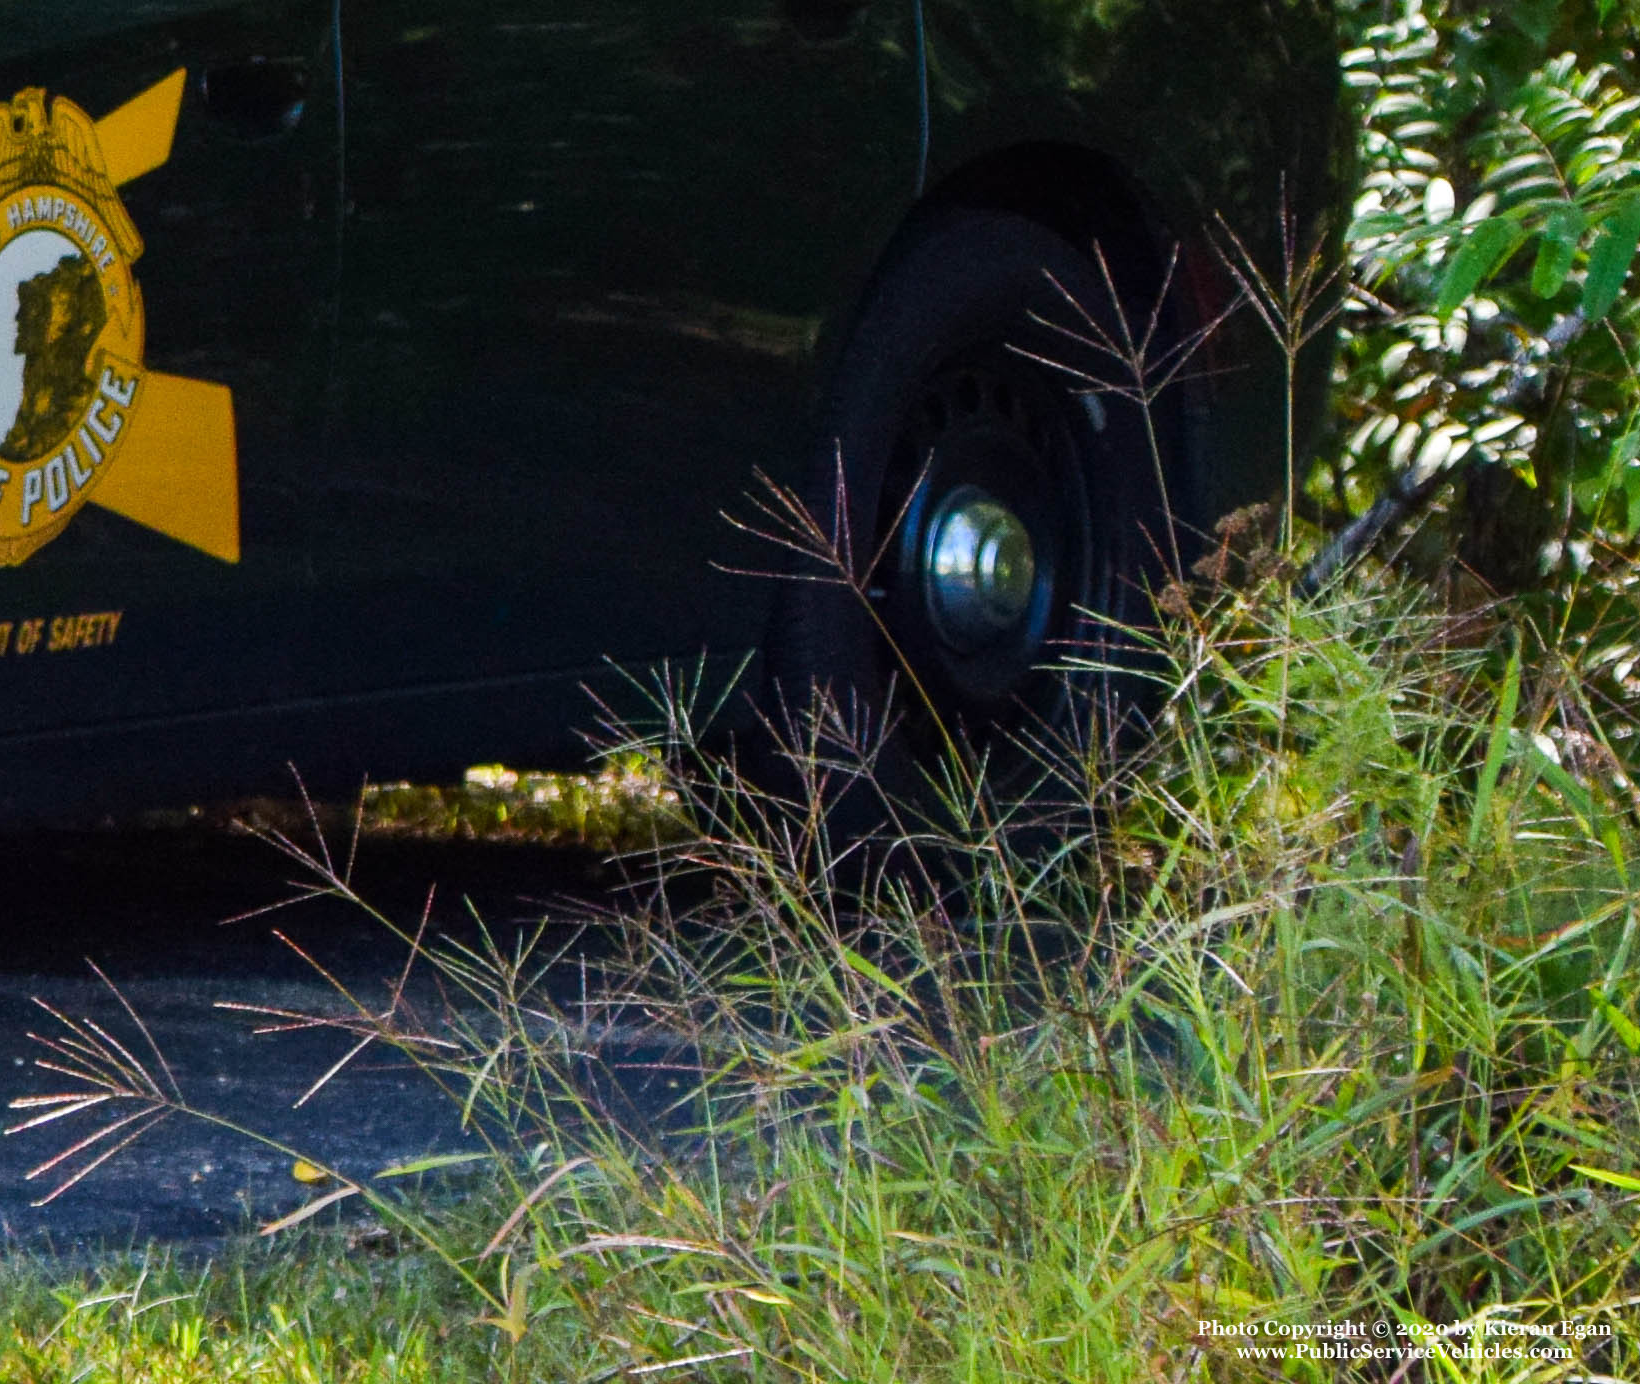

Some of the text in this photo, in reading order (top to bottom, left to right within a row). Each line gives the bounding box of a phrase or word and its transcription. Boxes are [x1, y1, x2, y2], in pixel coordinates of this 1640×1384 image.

[6, 196, 115, 272] HAMPSHIRE
[21, 367, 139, 526] POLICE
[16, 617, 45, 655] OF
[47, 611, 124, 652] SAFETY
